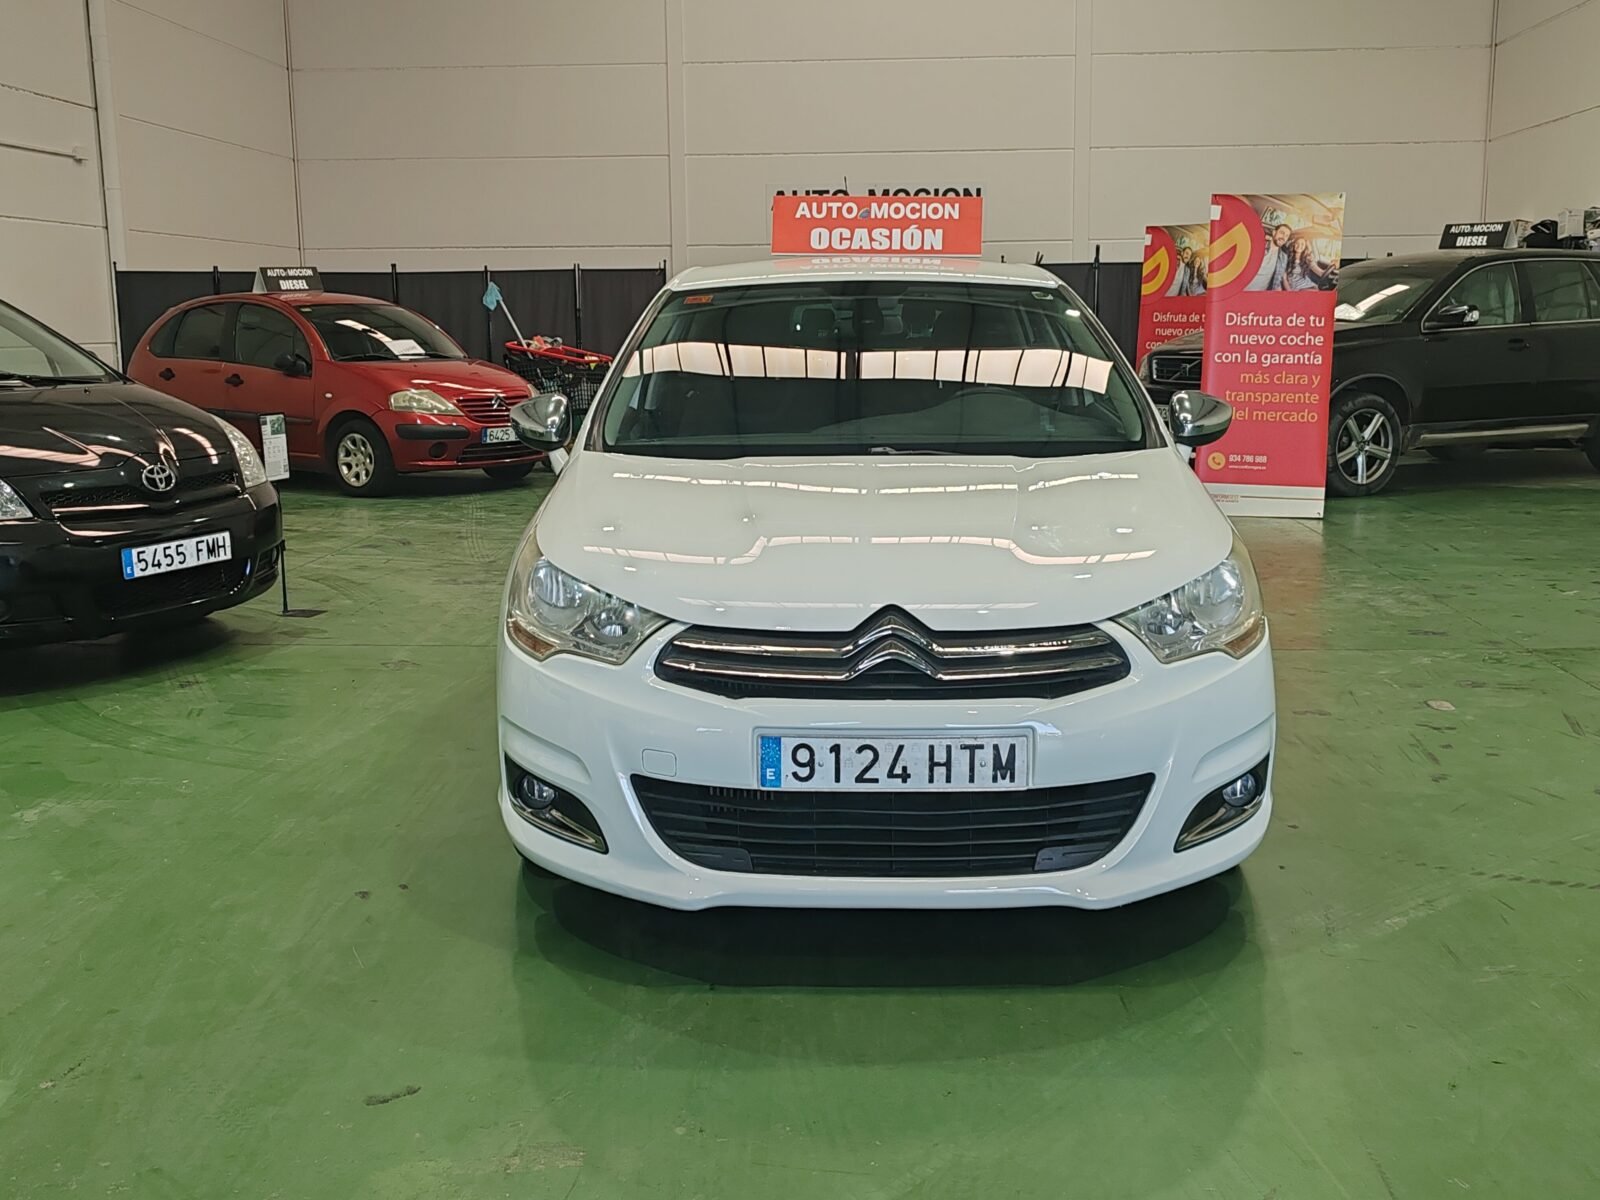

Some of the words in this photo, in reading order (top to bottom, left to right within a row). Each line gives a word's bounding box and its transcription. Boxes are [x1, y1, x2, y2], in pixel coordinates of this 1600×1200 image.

[795, 201, 858, 219] AUTO
[870, 202, 960, 220] MOCION
[1450, 225, 1470, 233] AUTO
[1473, 224, 1503, 232] MOCION
[810, 224, 943, 250] OCASIÓN
[1456, 236, 1487, 246] DIESEL
[266, 268, 287, 277] AUTO
[286, 268, 314, 276] MOCION
[279, 279, 309, 290] DIESEL
[1152, 311, 1187, 323] Disfruta
[1188, 311, 1200, 323] de
[1225, 312, 1282, 326] Disfruta
[1286, 313, 1306, 327] de
[1309, 315, 1325, 327] tu
[1155, 327, 1183, 336] nuevo
[1229, 334, 1276, 345] nuevo
[1279, 331, 1324, 346] coche
[1214, 352, 1241, 363] con
[1245, 349, 1257, 364] la
[1261, 351, 1323, 367] garantía
[1240, 370, 1270, 384] más
[1273, 371, 1308, 385] clara
[1311, 375, 1321, 388] y
[1225, 390, 1320, 406] transparente
[1231, 407, 1249, 421] el
[1252, 408, 1318, 423] mercado
[489, 429, 511, 441] 6425
[136, 543, 187, 573] 5455
[196, 535, 228, 562] FMH
[766, 768, 776, 780] E
[791, 743, 912, 784] 9124
[927, 743, 1017, 784] HTM
